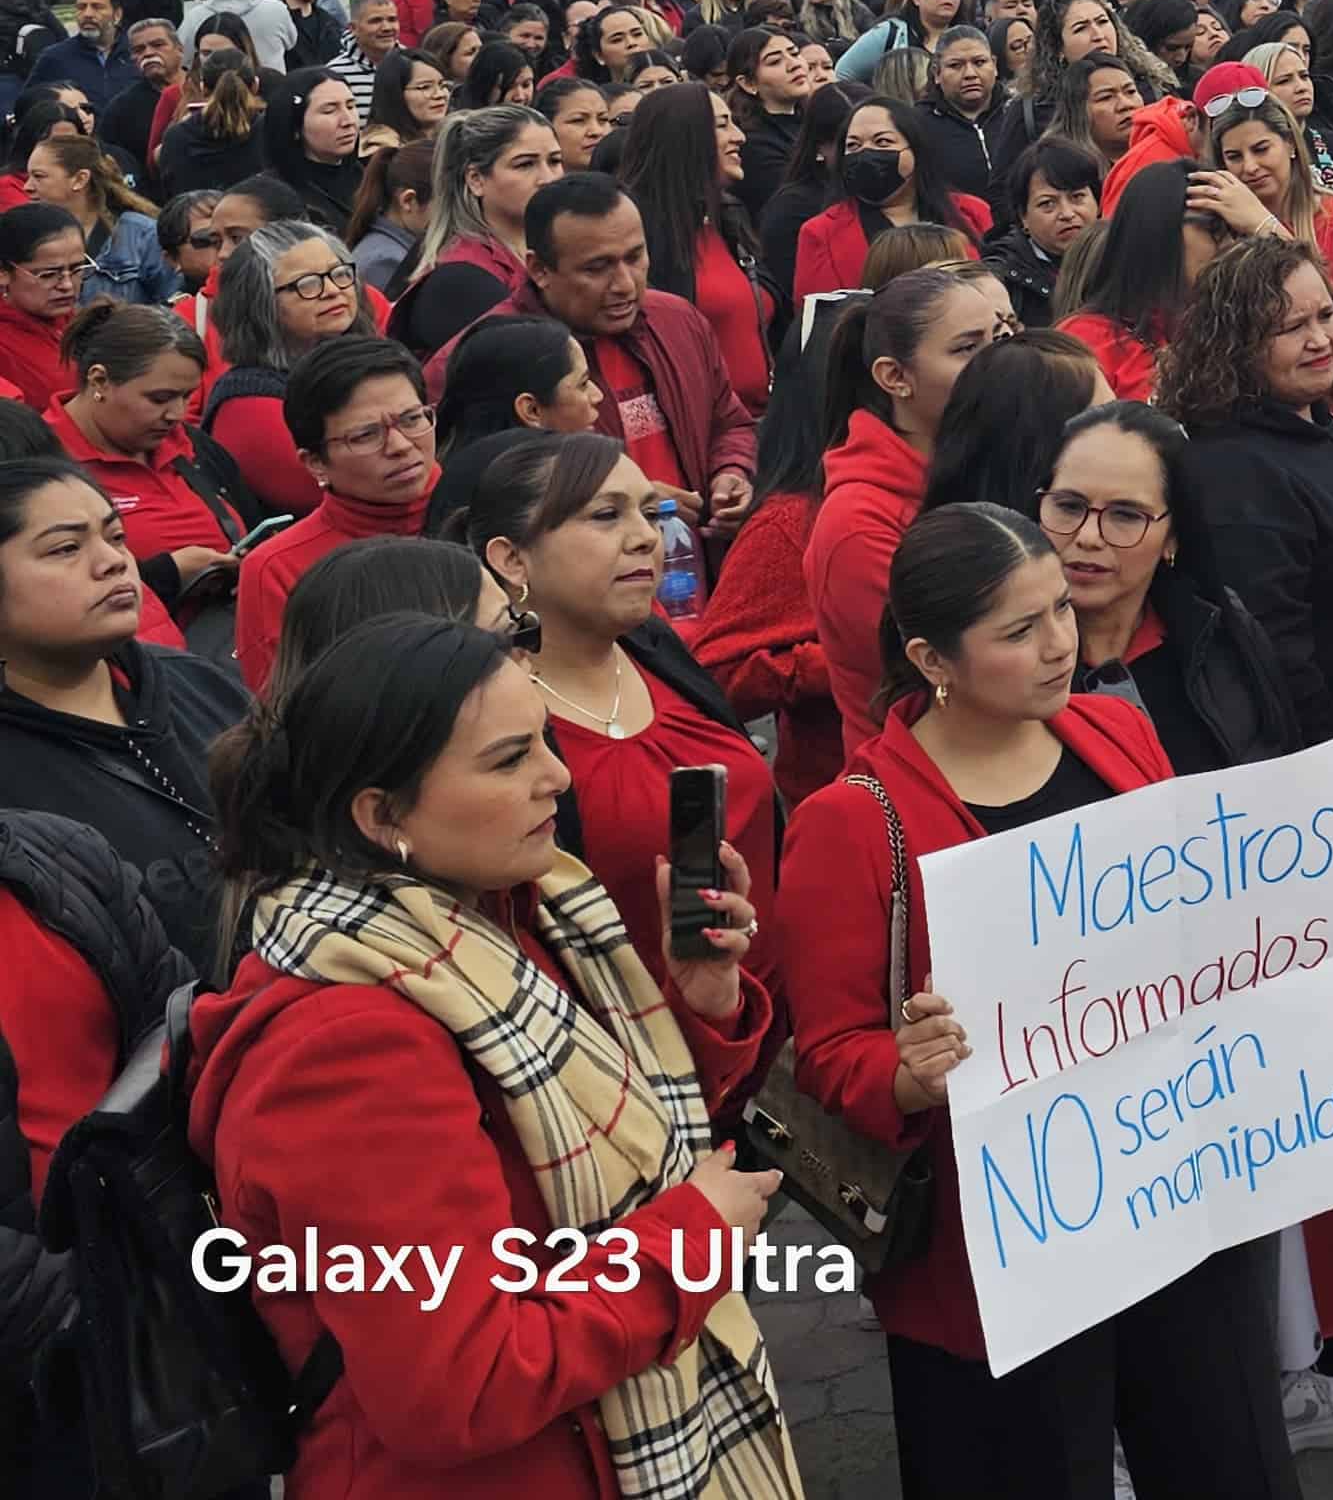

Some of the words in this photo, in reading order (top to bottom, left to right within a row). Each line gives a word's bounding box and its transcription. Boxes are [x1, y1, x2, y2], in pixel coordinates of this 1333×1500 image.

[998, 915, 1329, 1095] Informados
[981, 1092, 1104, 1269] NO
[1112, 1024, 1266, 1156] serán
